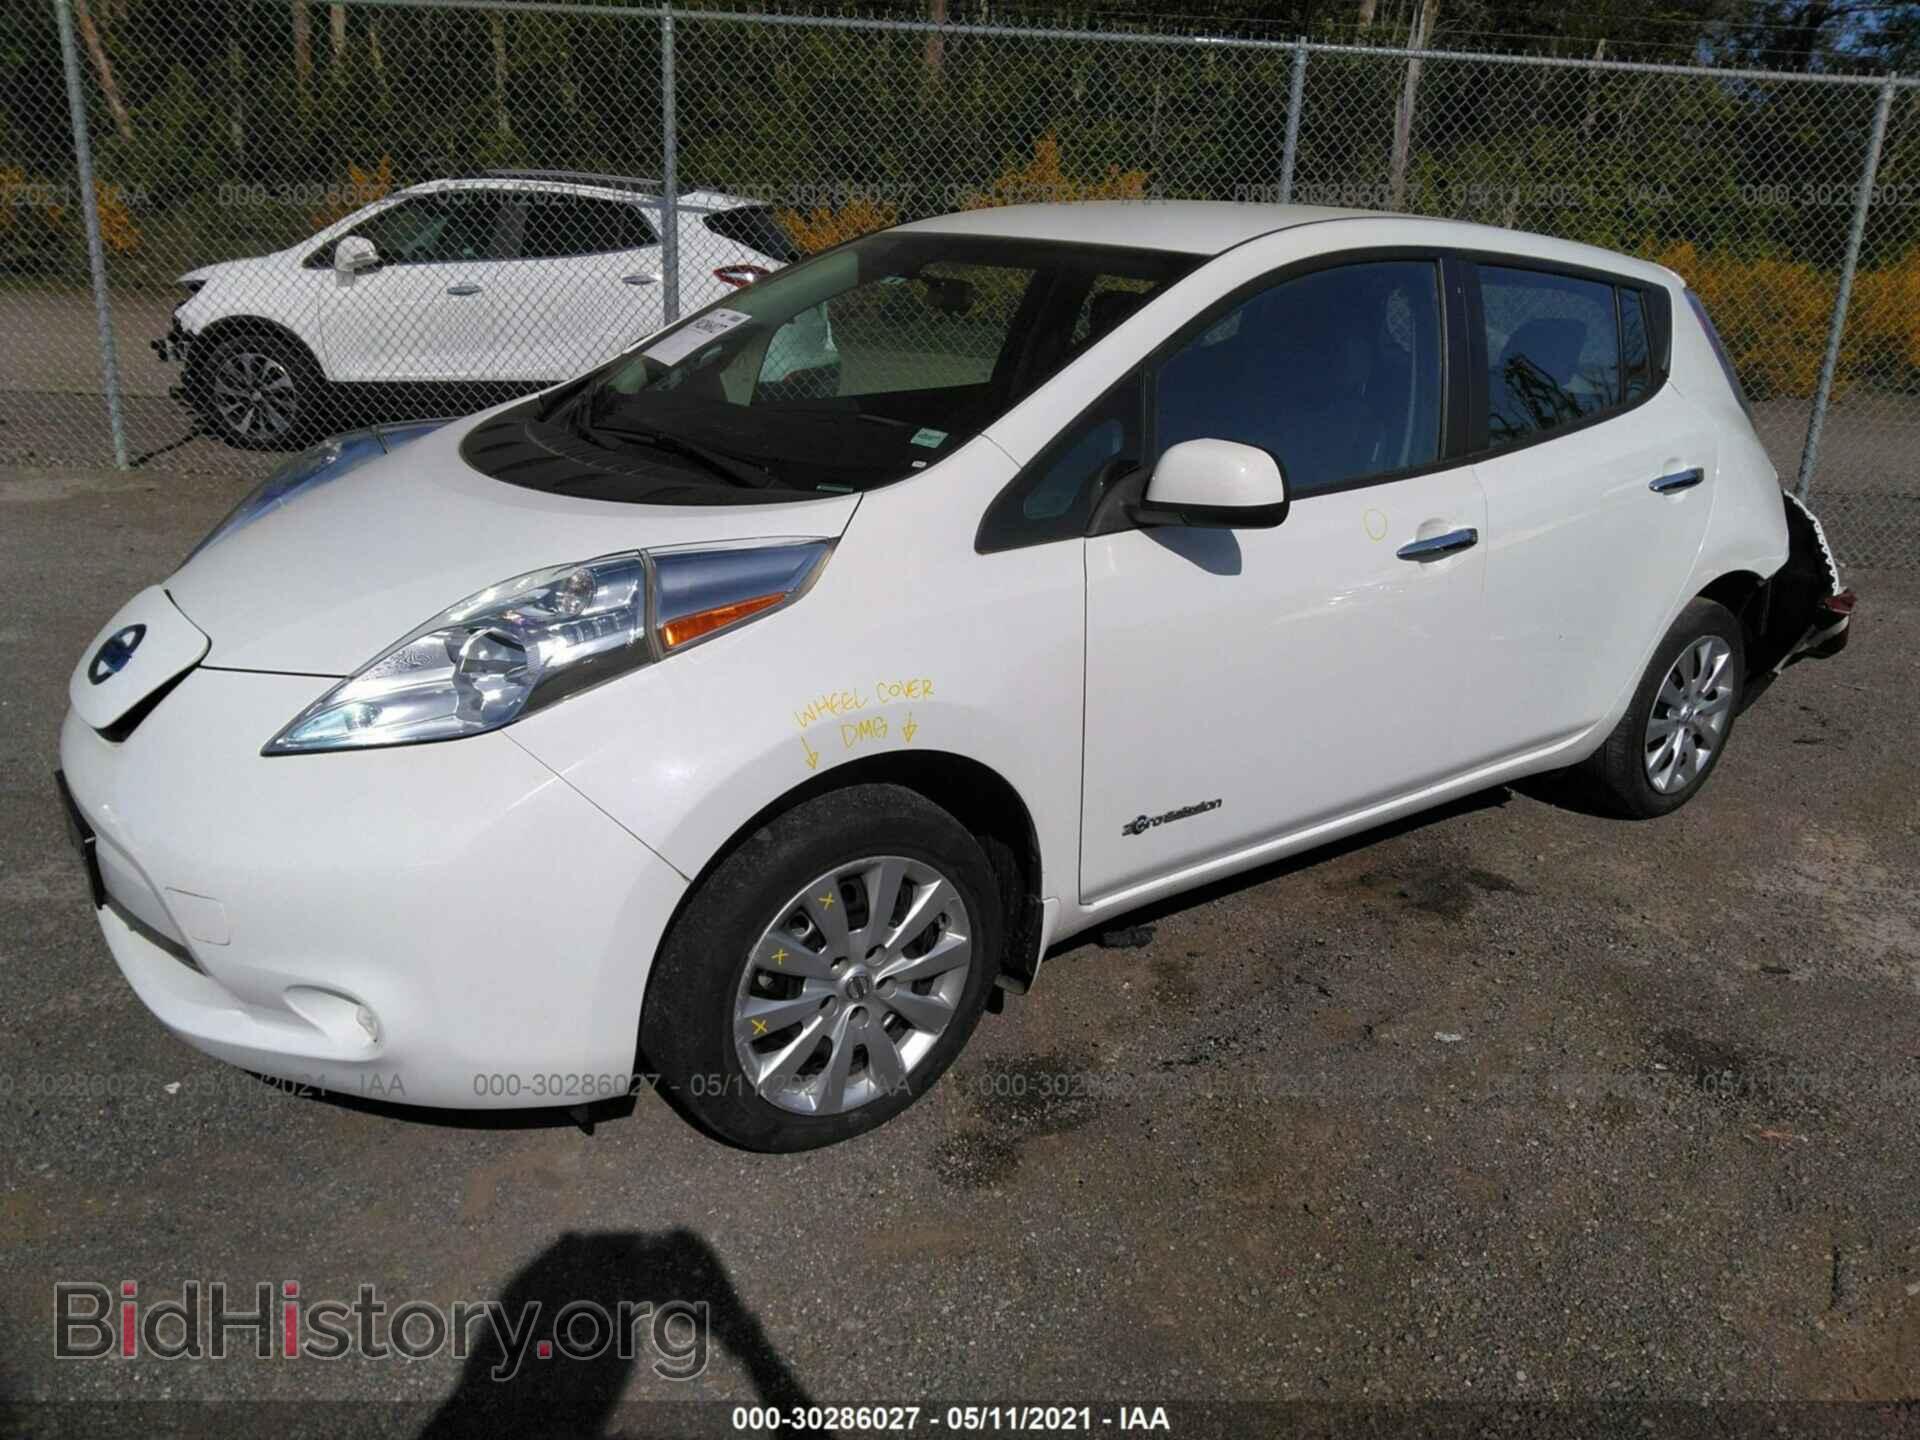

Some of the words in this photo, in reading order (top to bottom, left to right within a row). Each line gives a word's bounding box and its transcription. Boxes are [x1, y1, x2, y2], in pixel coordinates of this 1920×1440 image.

[794, 689, 868, 728] WHEEL
[876, 679, 935, 704] COVER
[841, 716, 887, 748] DMG
